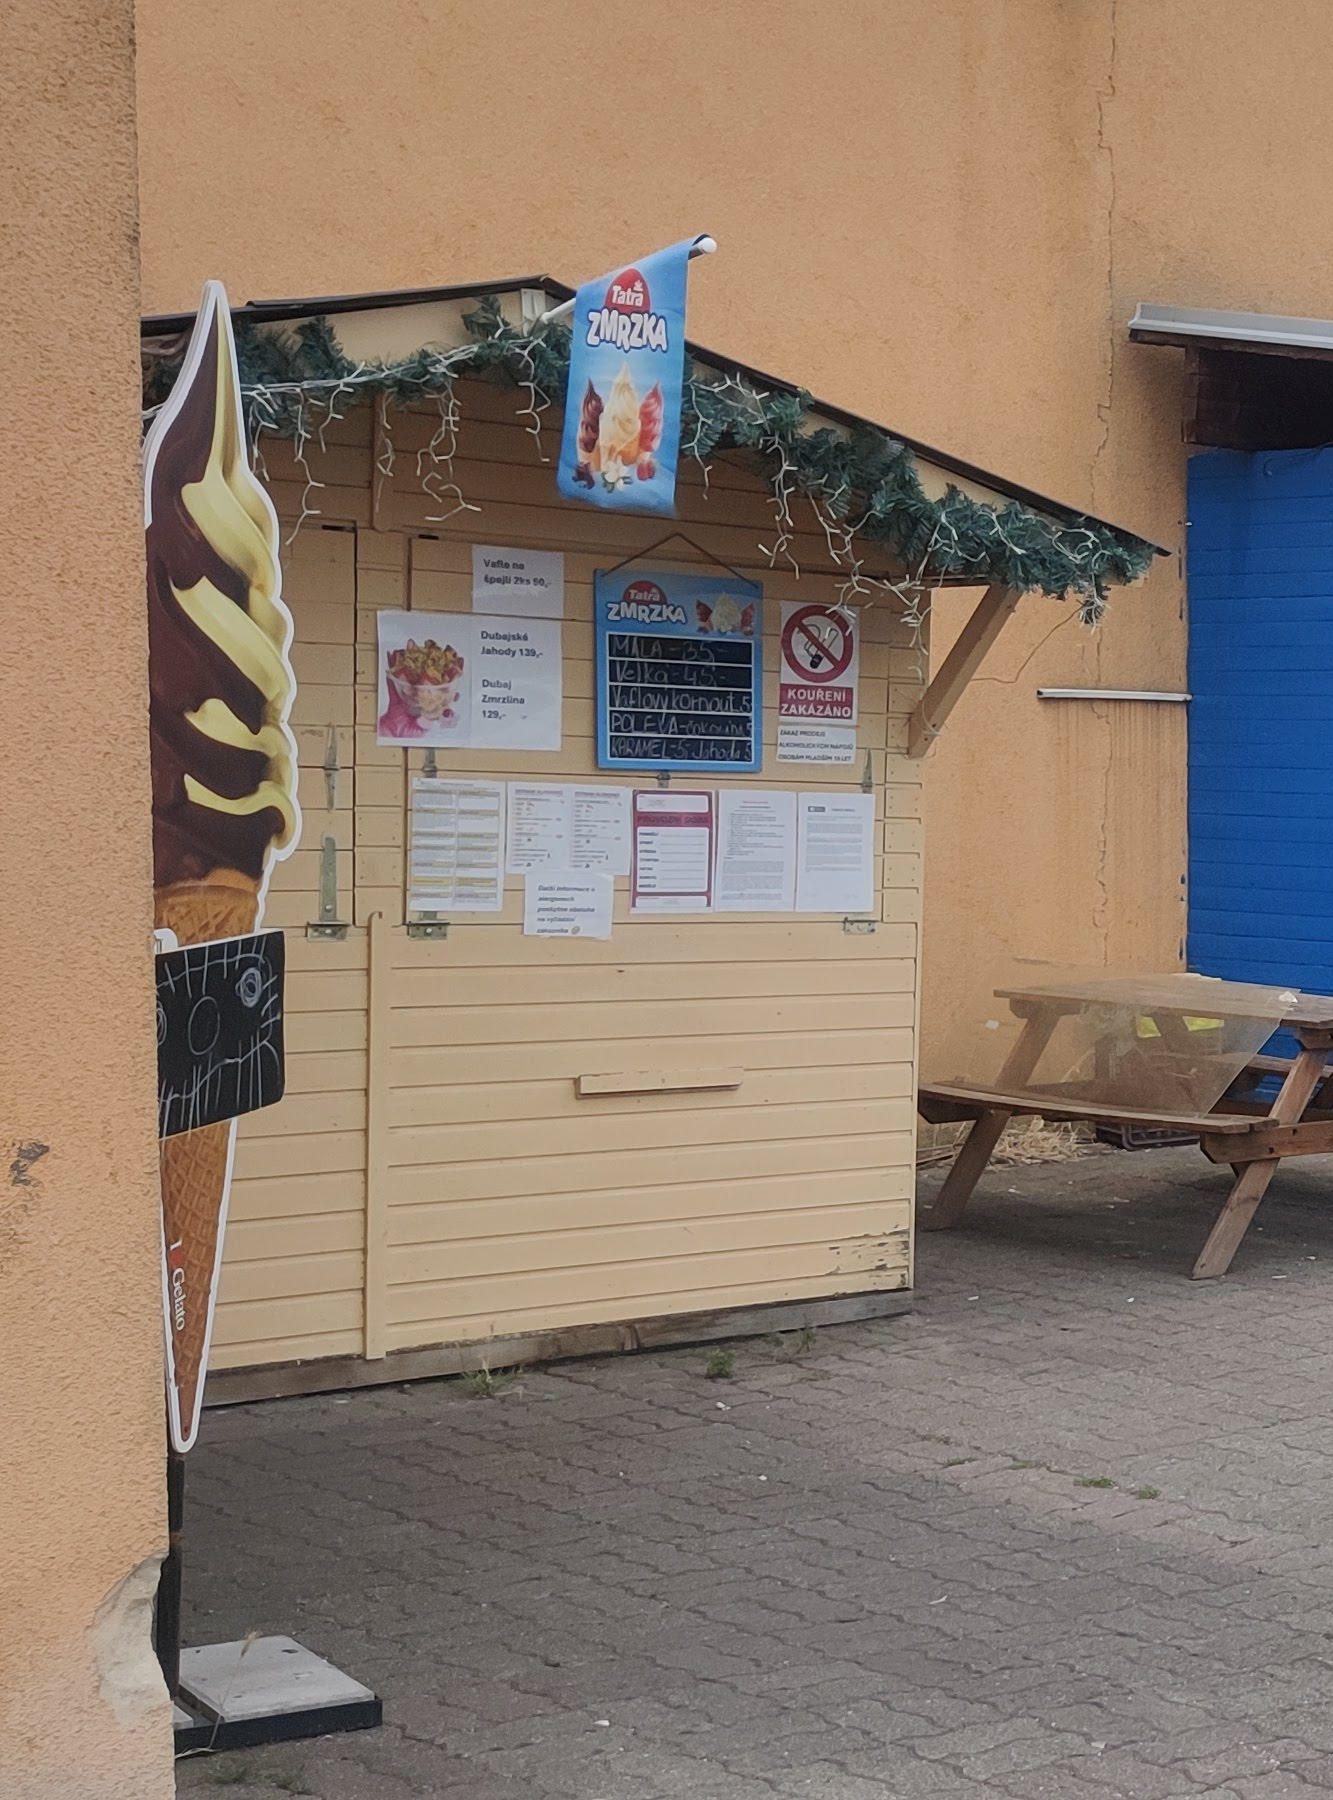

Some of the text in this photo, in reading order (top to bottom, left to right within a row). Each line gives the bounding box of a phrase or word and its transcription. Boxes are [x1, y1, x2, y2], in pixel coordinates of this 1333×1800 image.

[611, 284, 644, 306] Tatra
[587, 308, 668, 352] ZMRZKA
[483, 558, 525, 570] Vafle na
[513, 575, 531, 585] 2ks
[533, 576, 552, 588] 50,-
[629, 588, 661, 602] Tatra
[607, 601, 686, 624] ZMRZKA
[481, 630, 529, 642] Dubajské
[481, 646, 543, 659] Jahody 139,-
[482, 679, 512, 690] Dubaj
[482, 694, 525, 705] Zmrzlina
[787, 688, 846, 702] KOUŘENÍ
[482, 710, 507, 720] 129,-
[781, 702, 852, 718] ZAKÁZÁNO
[172, 1267, 187, 1332] Gelato
